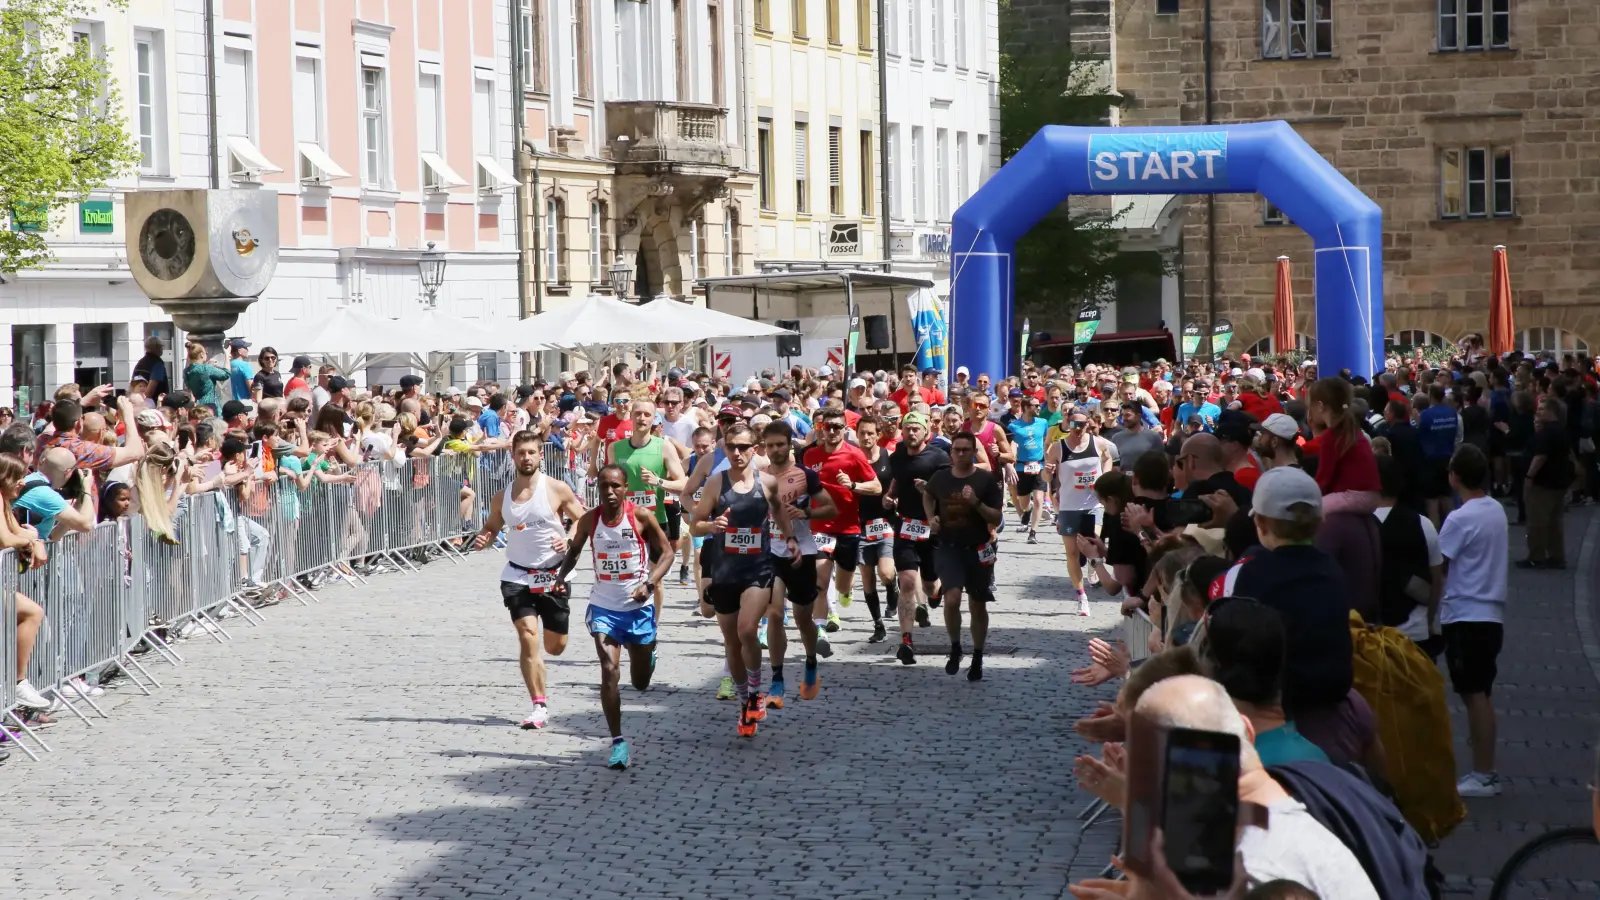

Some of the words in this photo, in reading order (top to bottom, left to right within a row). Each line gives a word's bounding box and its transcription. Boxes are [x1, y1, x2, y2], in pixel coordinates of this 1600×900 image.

[1095, 149, 1222, 181] START
[905, 523, 926, 535] 2635
[730, 534, 756, 545] 2501
[601, 559, 628, 571] 2513
